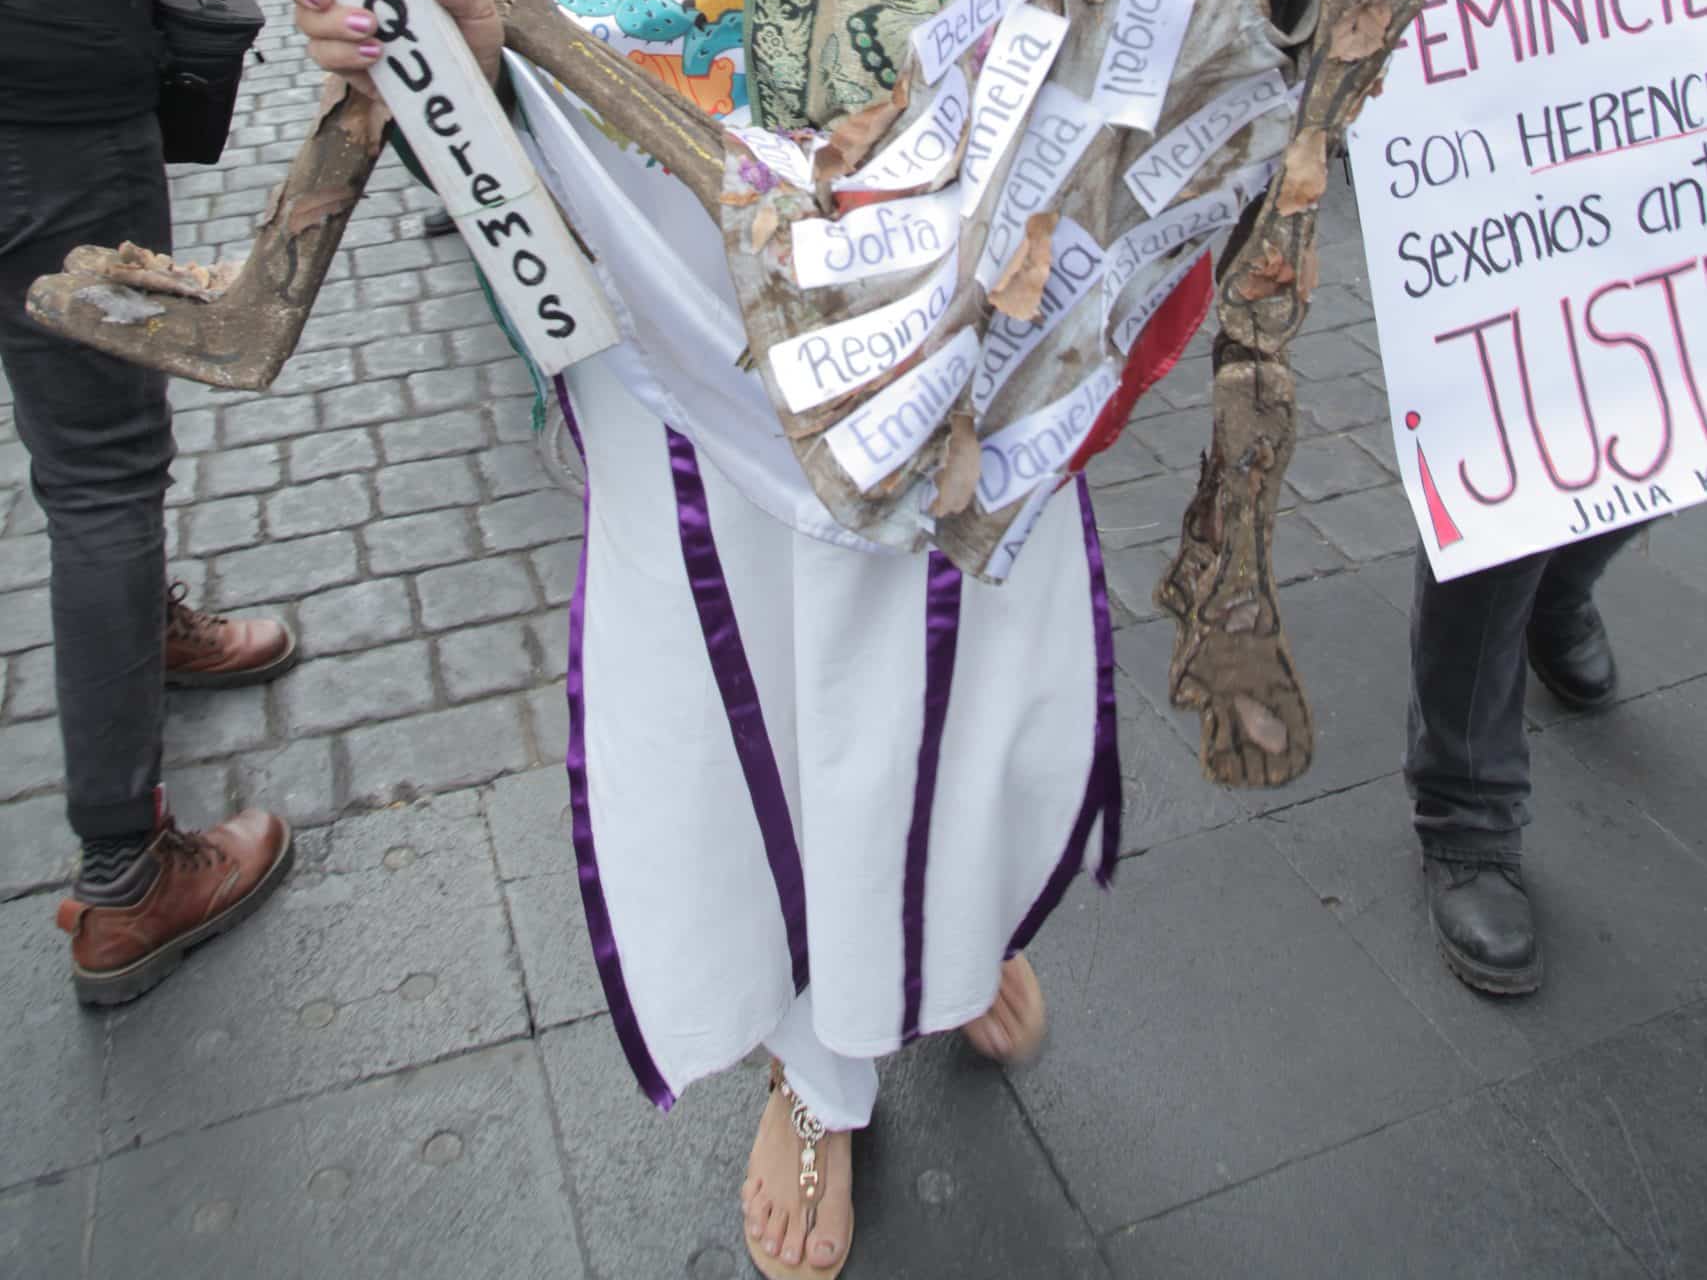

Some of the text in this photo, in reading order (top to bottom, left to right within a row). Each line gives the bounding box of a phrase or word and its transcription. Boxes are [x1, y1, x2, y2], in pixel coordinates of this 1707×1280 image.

[1132, 74, 1286, 204] Melissa
[824, 207, 940, 272] Sofía
[798, 286, 947, 389] Regina
[848, 355, 967, 464] Emilia
